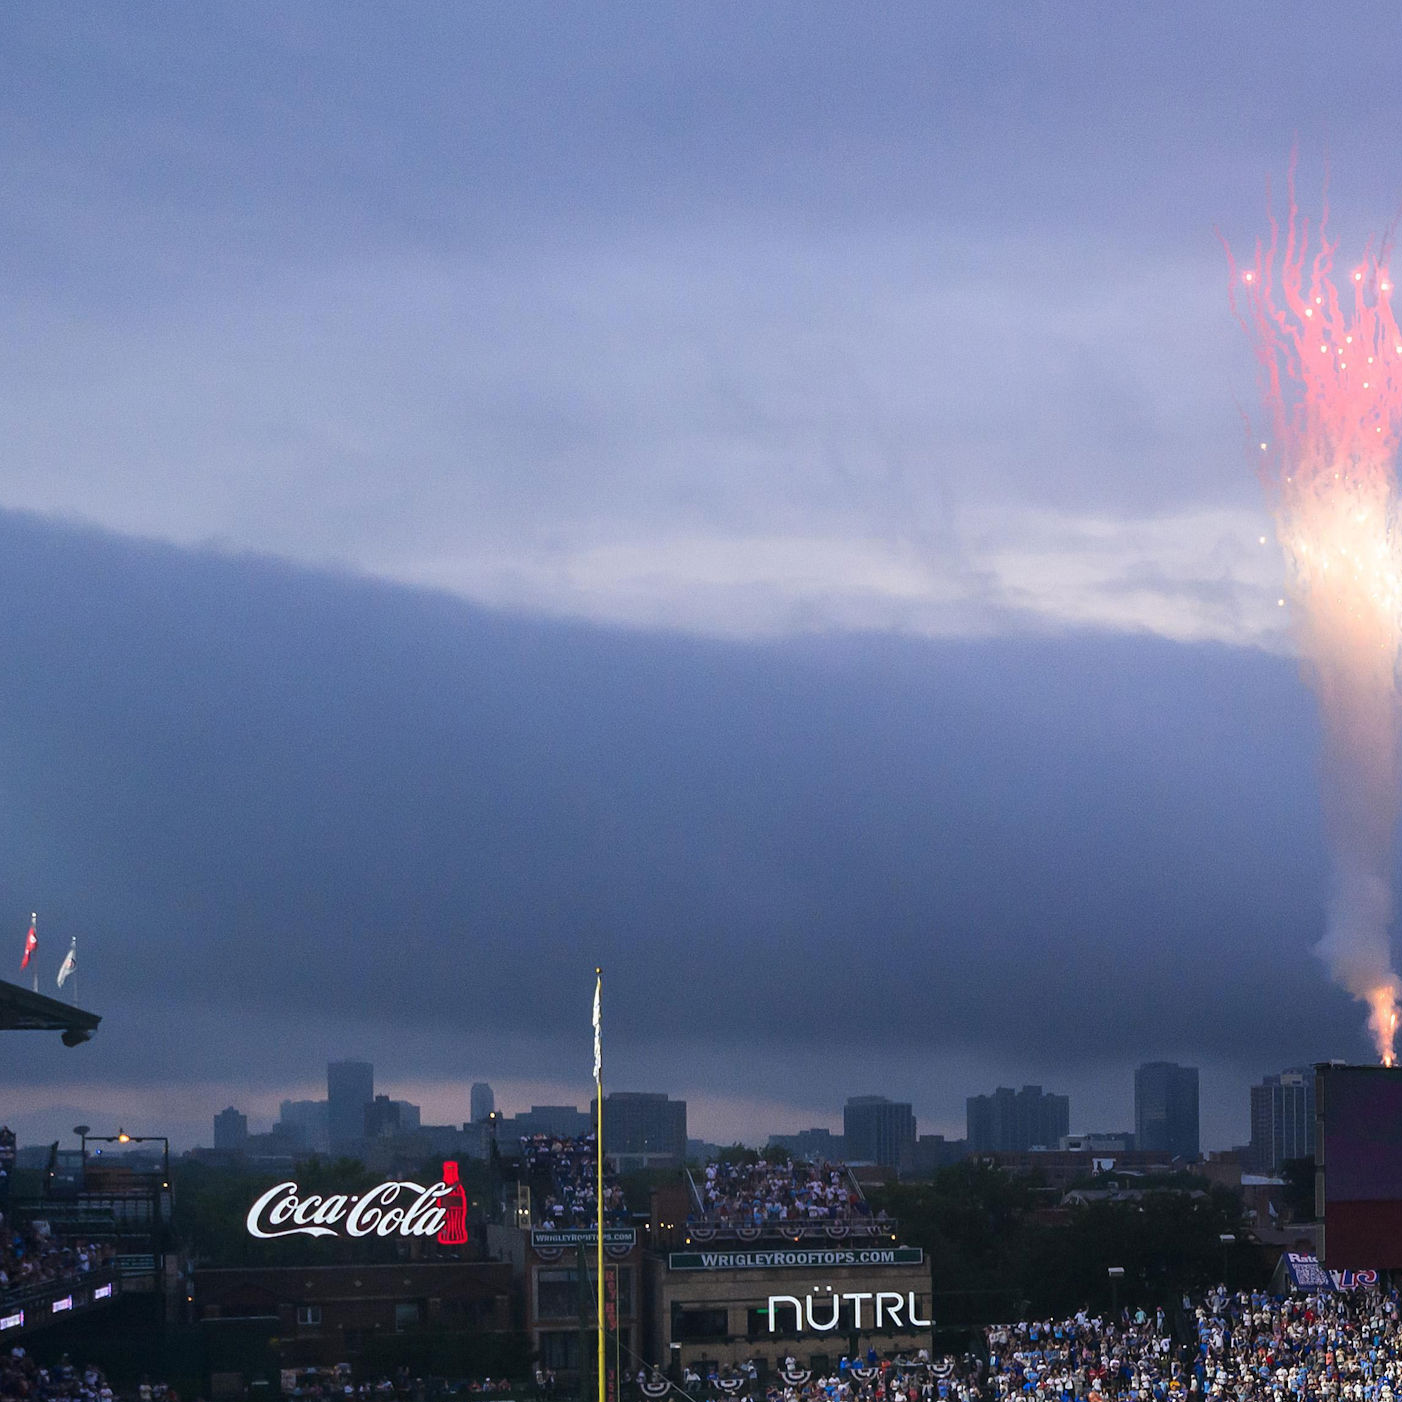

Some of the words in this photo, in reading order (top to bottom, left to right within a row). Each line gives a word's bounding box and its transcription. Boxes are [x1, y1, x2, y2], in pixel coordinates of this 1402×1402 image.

[247, 1180, 455, 1238] Coca-Cola
[535, 1232, 633, 1242] WRIGLEYROOFTPS.COM
[700, 1249, 895, 1267] WRIGLEYROOFTOPS.COM
